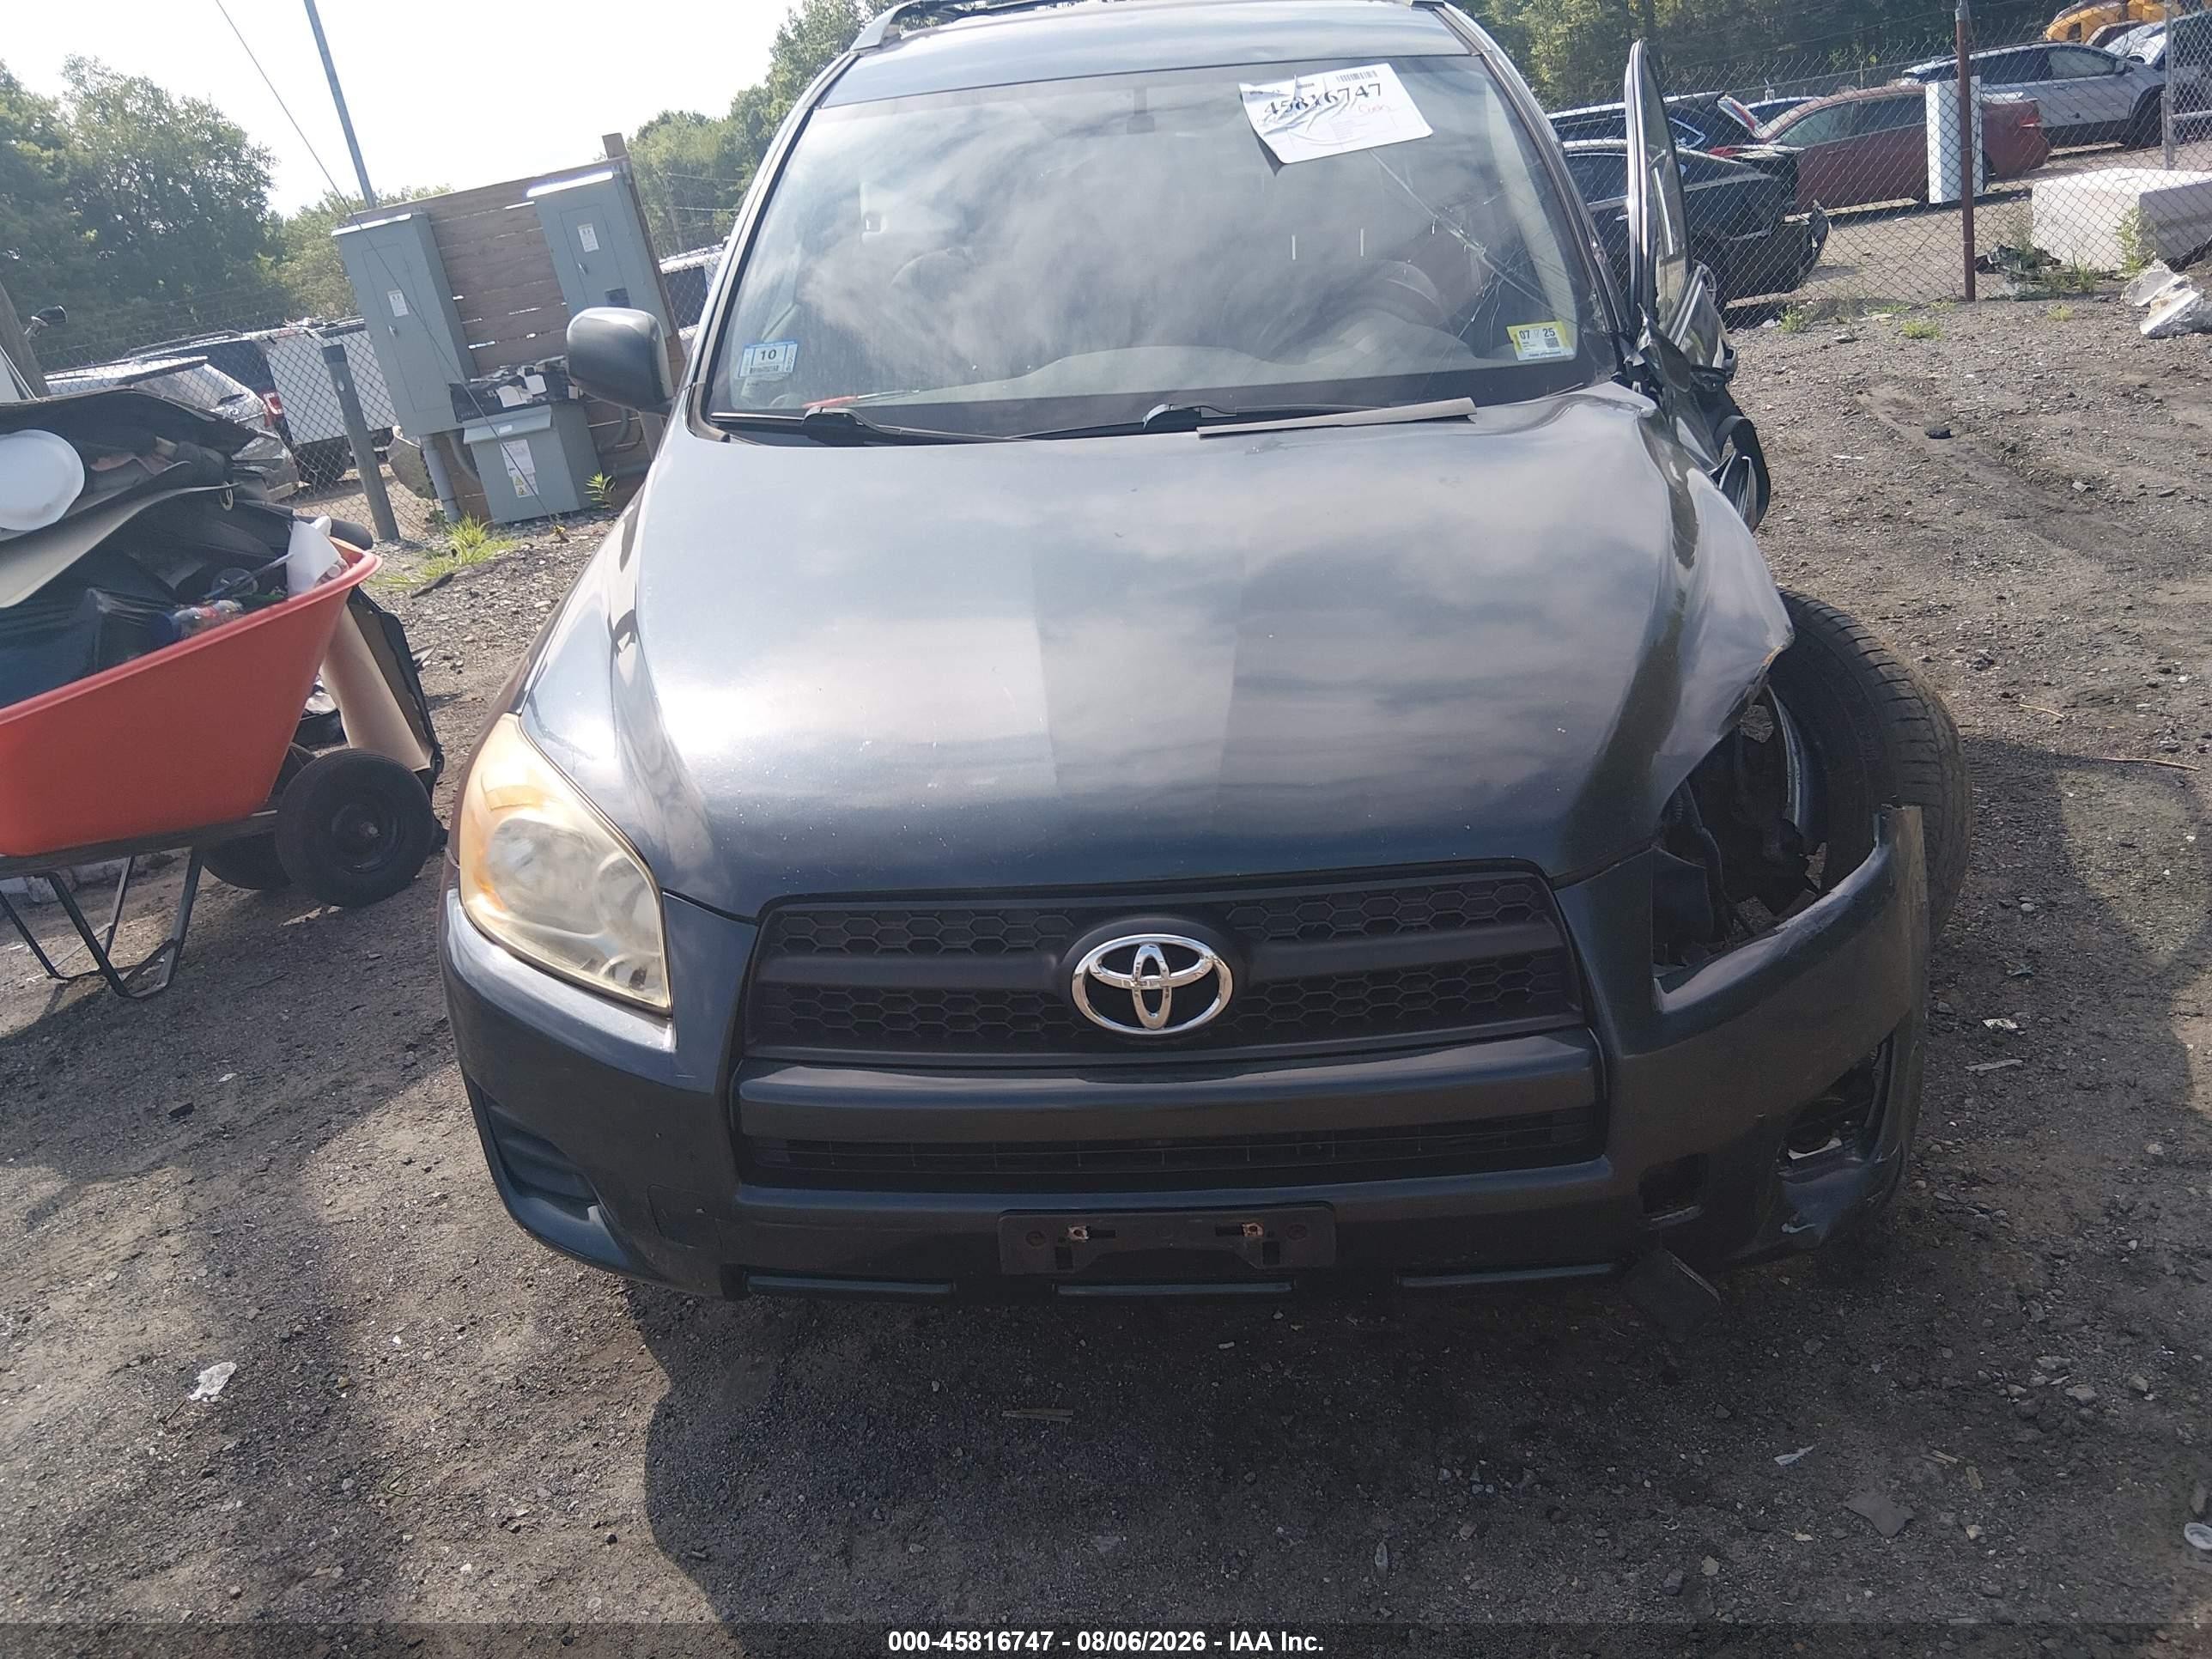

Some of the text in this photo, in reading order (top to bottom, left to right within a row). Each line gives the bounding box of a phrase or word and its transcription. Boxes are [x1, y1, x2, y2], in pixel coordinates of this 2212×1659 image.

[1519, 327, 1556, 340] 07 25
[761, 349, 777, 361] 10
